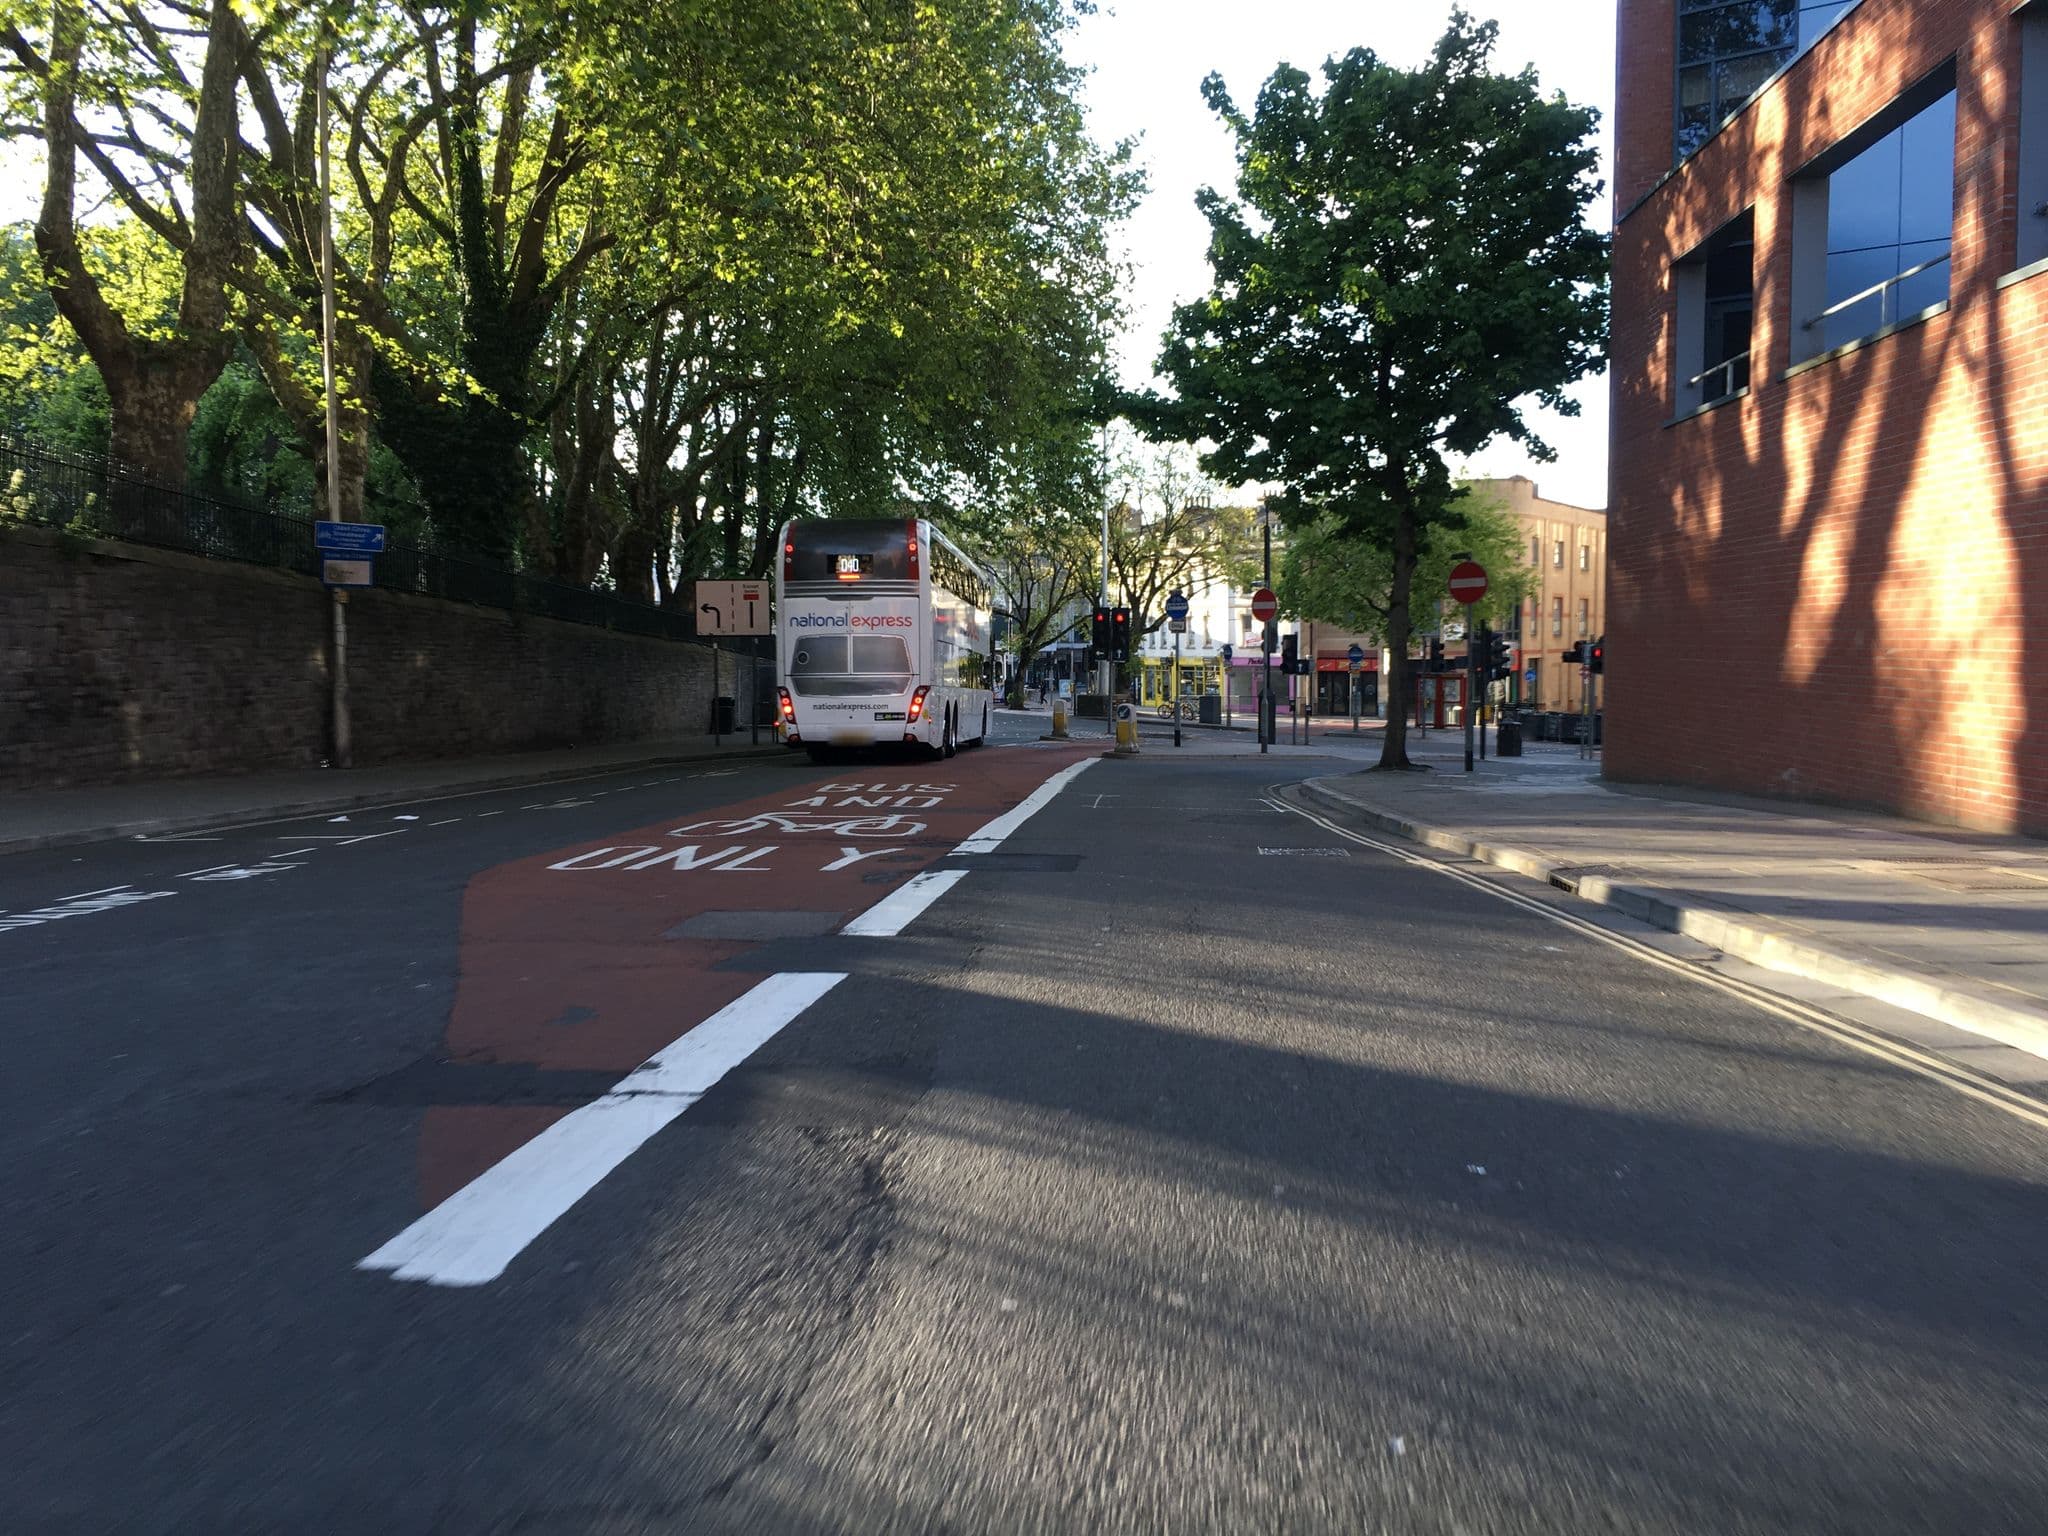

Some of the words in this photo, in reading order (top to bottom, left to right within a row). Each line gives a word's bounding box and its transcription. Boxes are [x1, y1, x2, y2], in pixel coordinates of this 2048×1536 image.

[789, 613, 849, 627] national
[851, 616, 913, 630] express
[813, 703, 889, 711] nationalexpress.com
[816, 783, 960, 792] BUS
[784, 796, 944, 808] AND
[546, 845, 906, 871] ONLY
